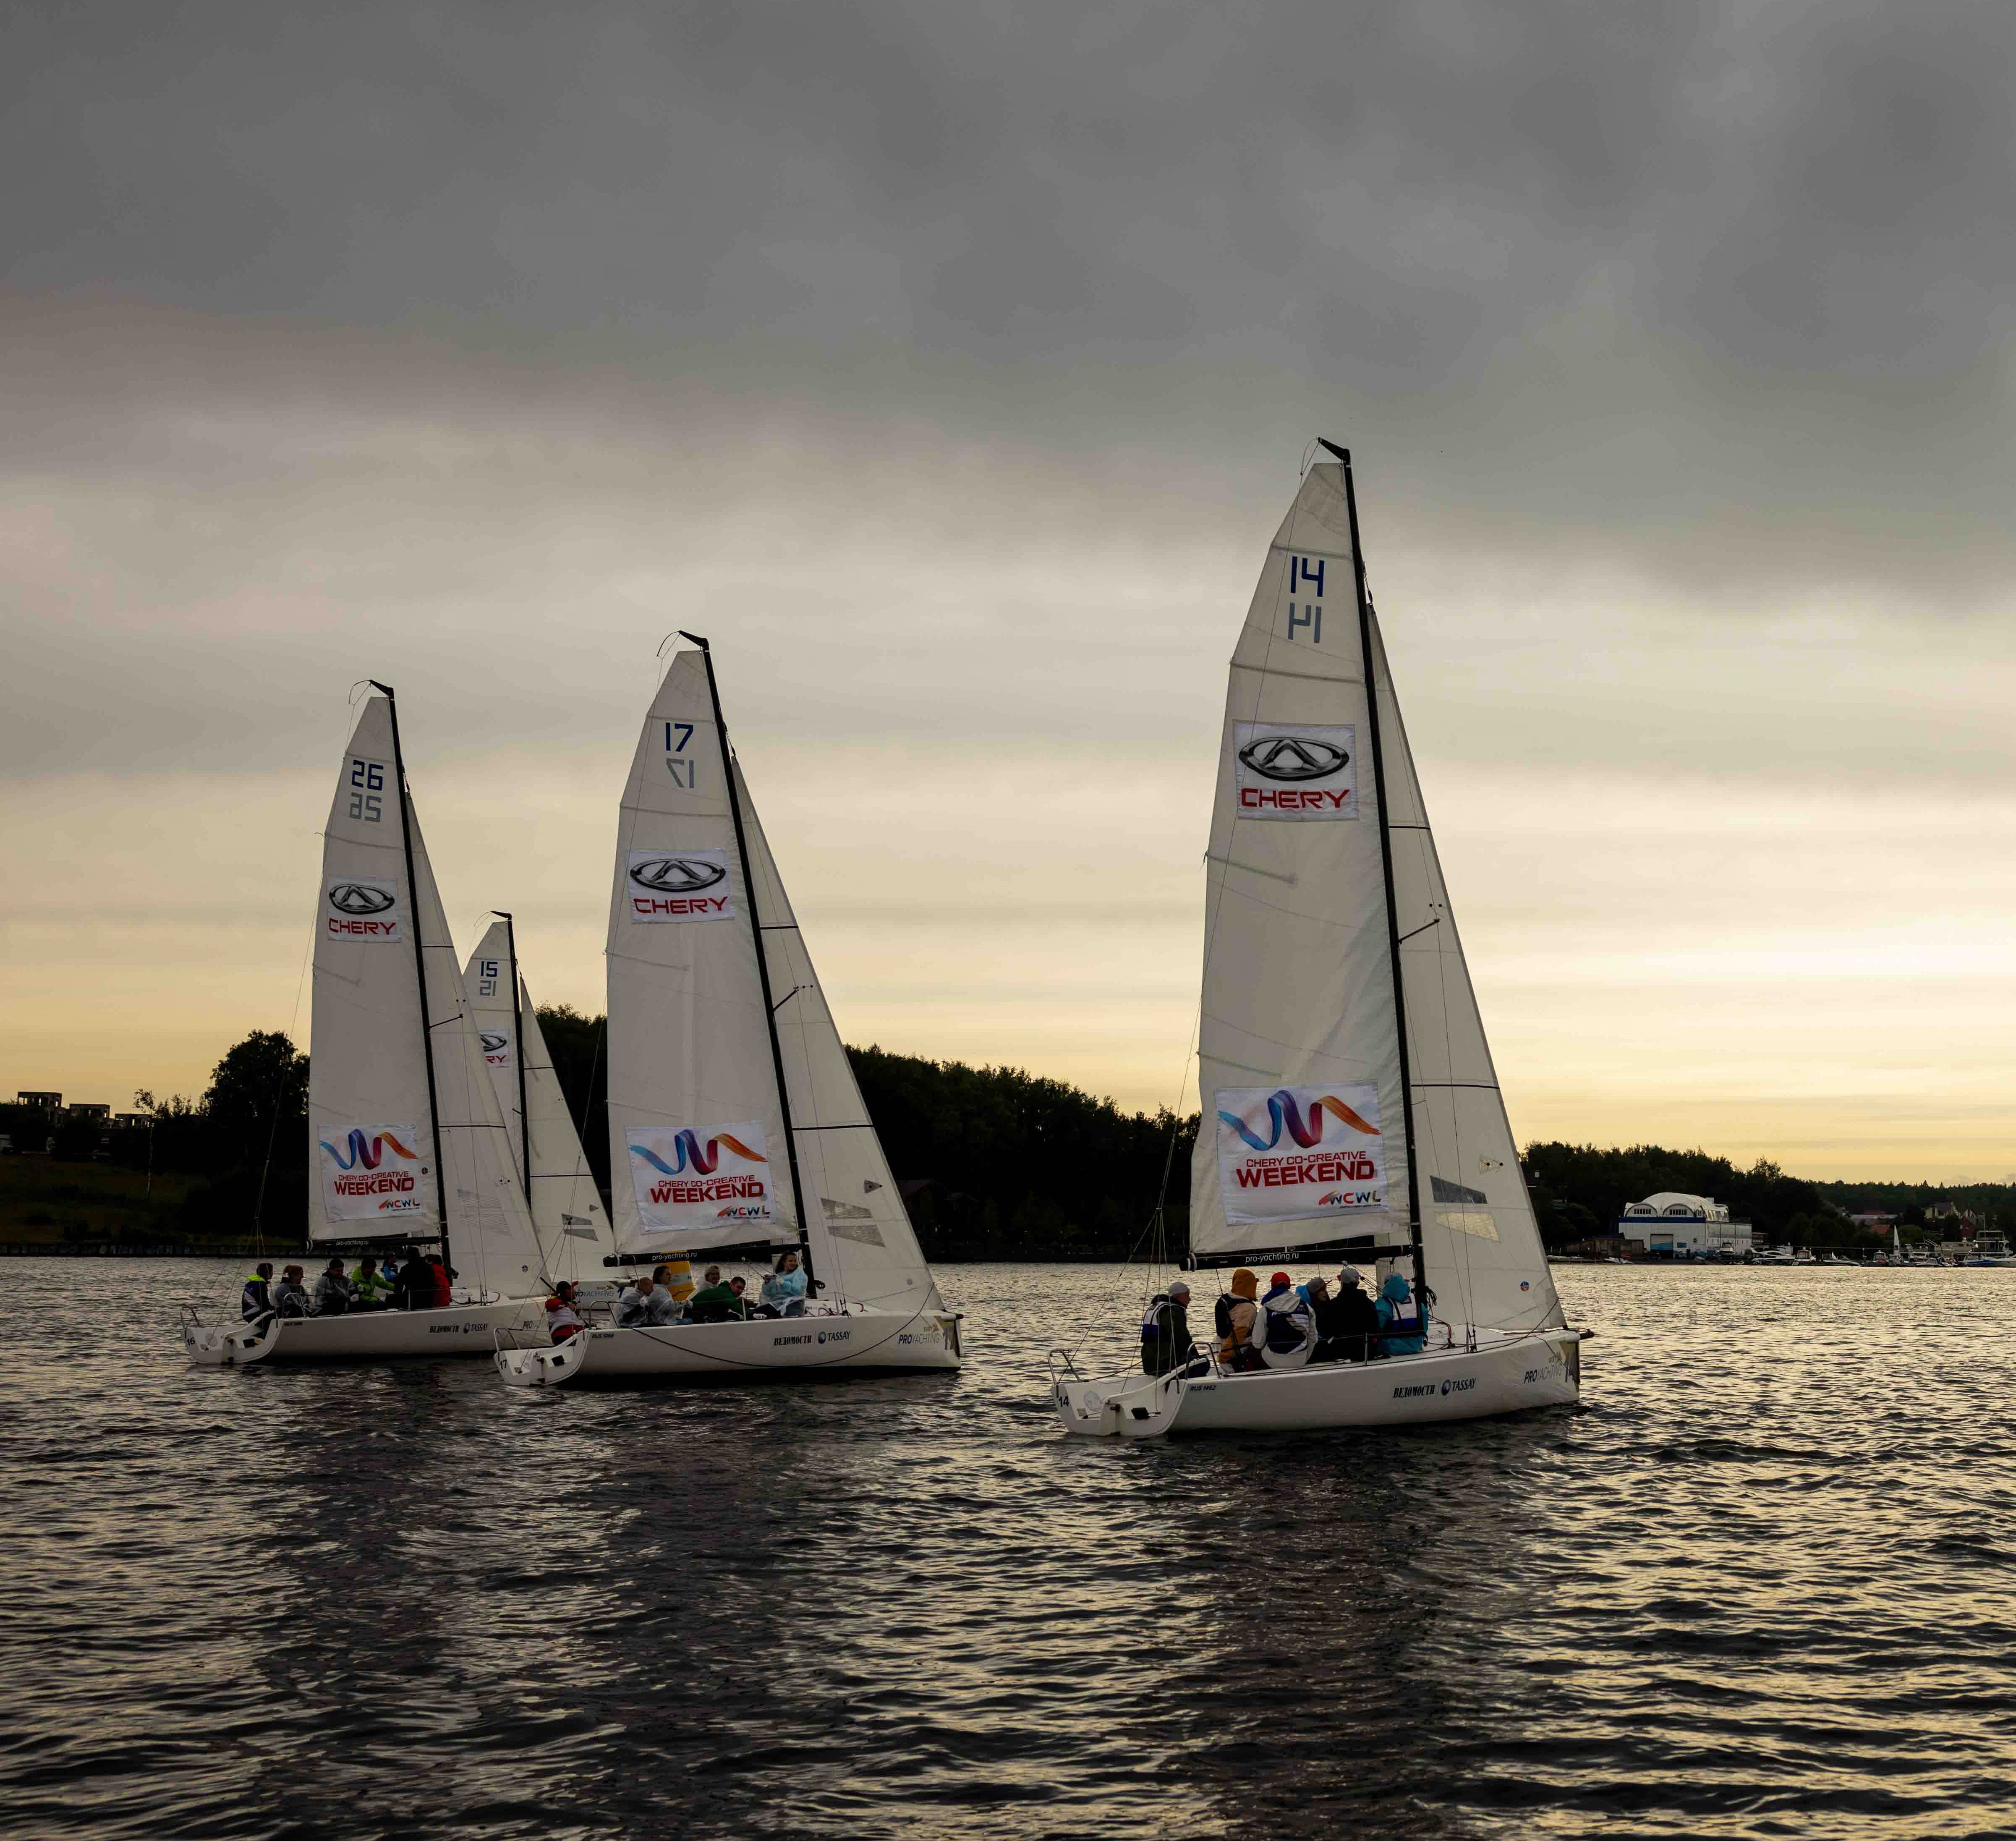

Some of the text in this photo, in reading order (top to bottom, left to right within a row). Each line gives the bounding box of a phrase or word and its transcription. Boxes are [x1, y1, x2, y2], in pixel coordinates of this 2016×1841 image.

[1291, 556, 1324, 597] 14
[666, 722, 693, 752] 17
[352, 760, 383, 790] 26
[1242, 788, 1350, 808] CHERY
[634, 896, 728, 913] CHERY
[329, 918, 396, 935] CHERY
[481, 961, 497, 977] 15
[1247, 1151, 1366, 1167] CHERY CO-CREATIVE
[359, 1171, 409, 1181] CO-CREATIVE
[691, 1175, 755, 1187] CO-CREATIVE
[1236, 1161, 1374, 1187] WEEKEND
[334, 1177, 414, 1195] WEEKEND
[650, 1182, 764, 1203] WEEKEND
[386, 1197, 420, 1208] WCWL
[1330, 1190, 1381, 1205] WCWL
[726, 1206, 771, 1216] WCWL
[652, 1250, 697, 1262] pro-yachting.ru
[1245, 1253, 1300, 1264] pro-yachting.ru
[827, 1331, 851, 1341] TASSAY
[499, 1359, 507, 1369] 17
[1451, 1378, 1477, 1392] TASSAY
[1059, 1396, 1069, 1407] 14
